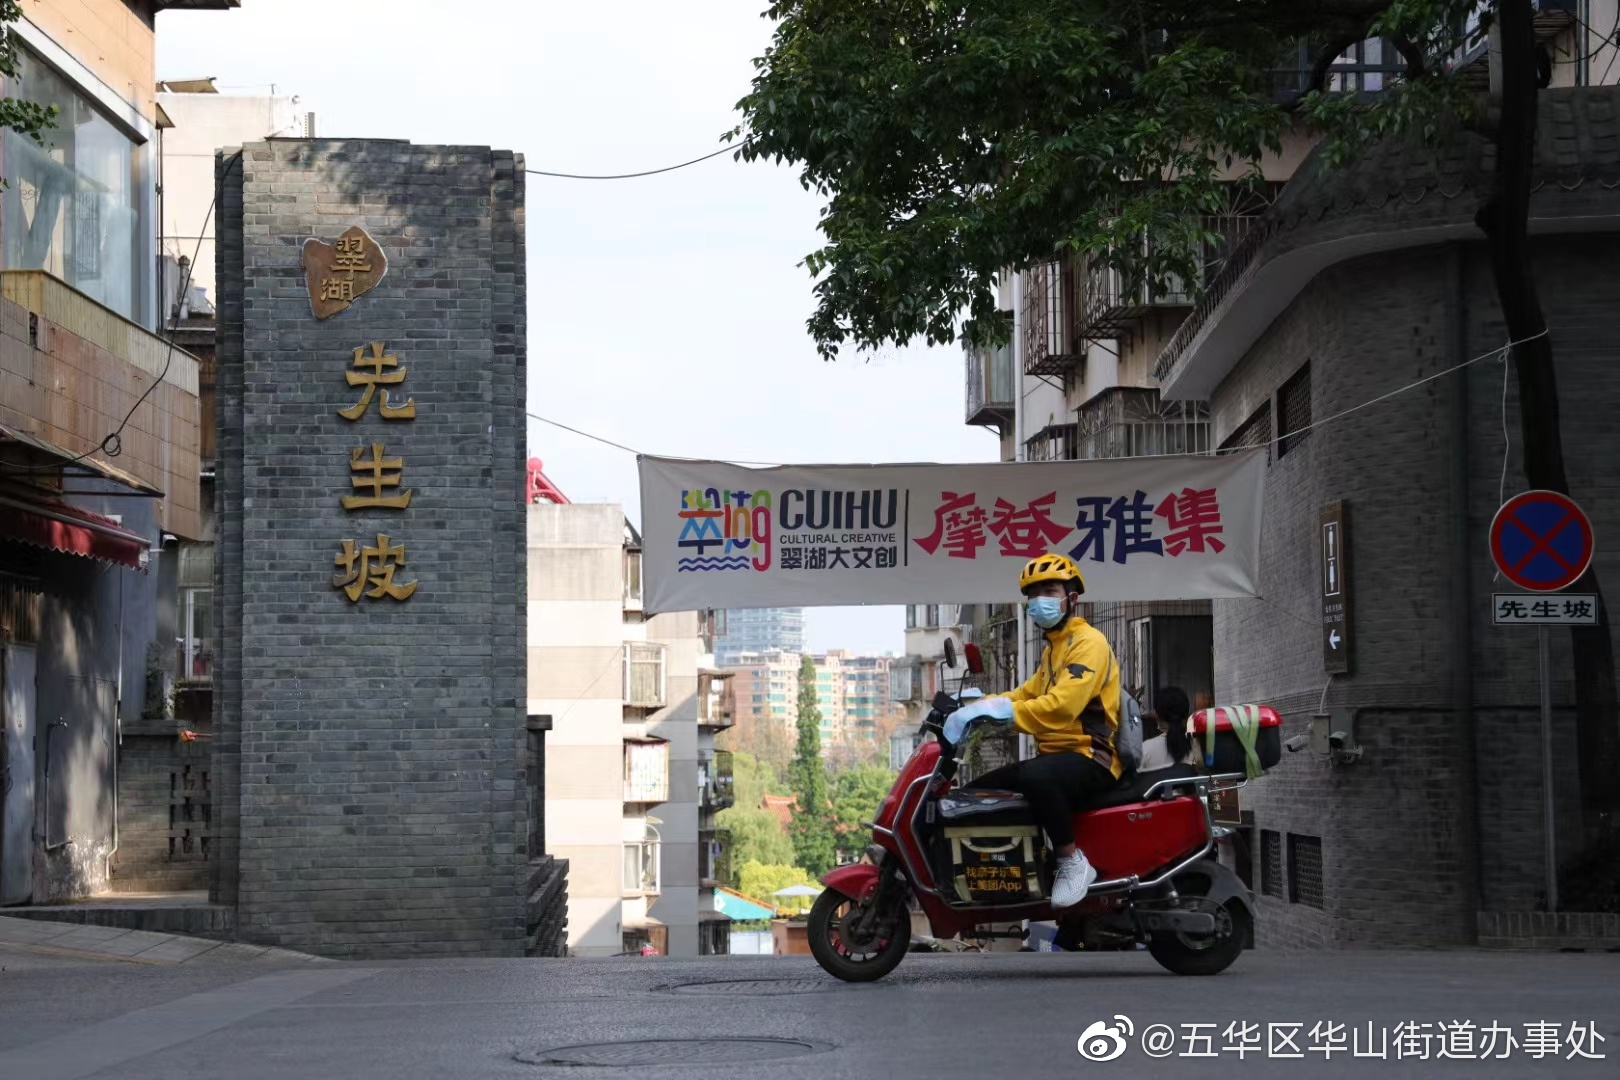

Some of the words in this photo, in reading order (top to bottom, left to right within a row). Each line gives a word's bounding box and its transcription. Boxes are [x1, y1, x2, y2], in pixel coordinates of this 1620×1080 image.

[320, 235, 372, 301] 翠湖
[333, 341, 418, 602] 先生坡
[779, 488, 898, 530] CUIHU
[912, 487, 1226, 565] 摩登雅集
[779, 535, 839, 545] CULTURAL
[841, 533, 896, 544] CREATIVE
[780, 546, 898, 570] 翠湖大文创
[1498, 600, 1593, 619] 先生坡
